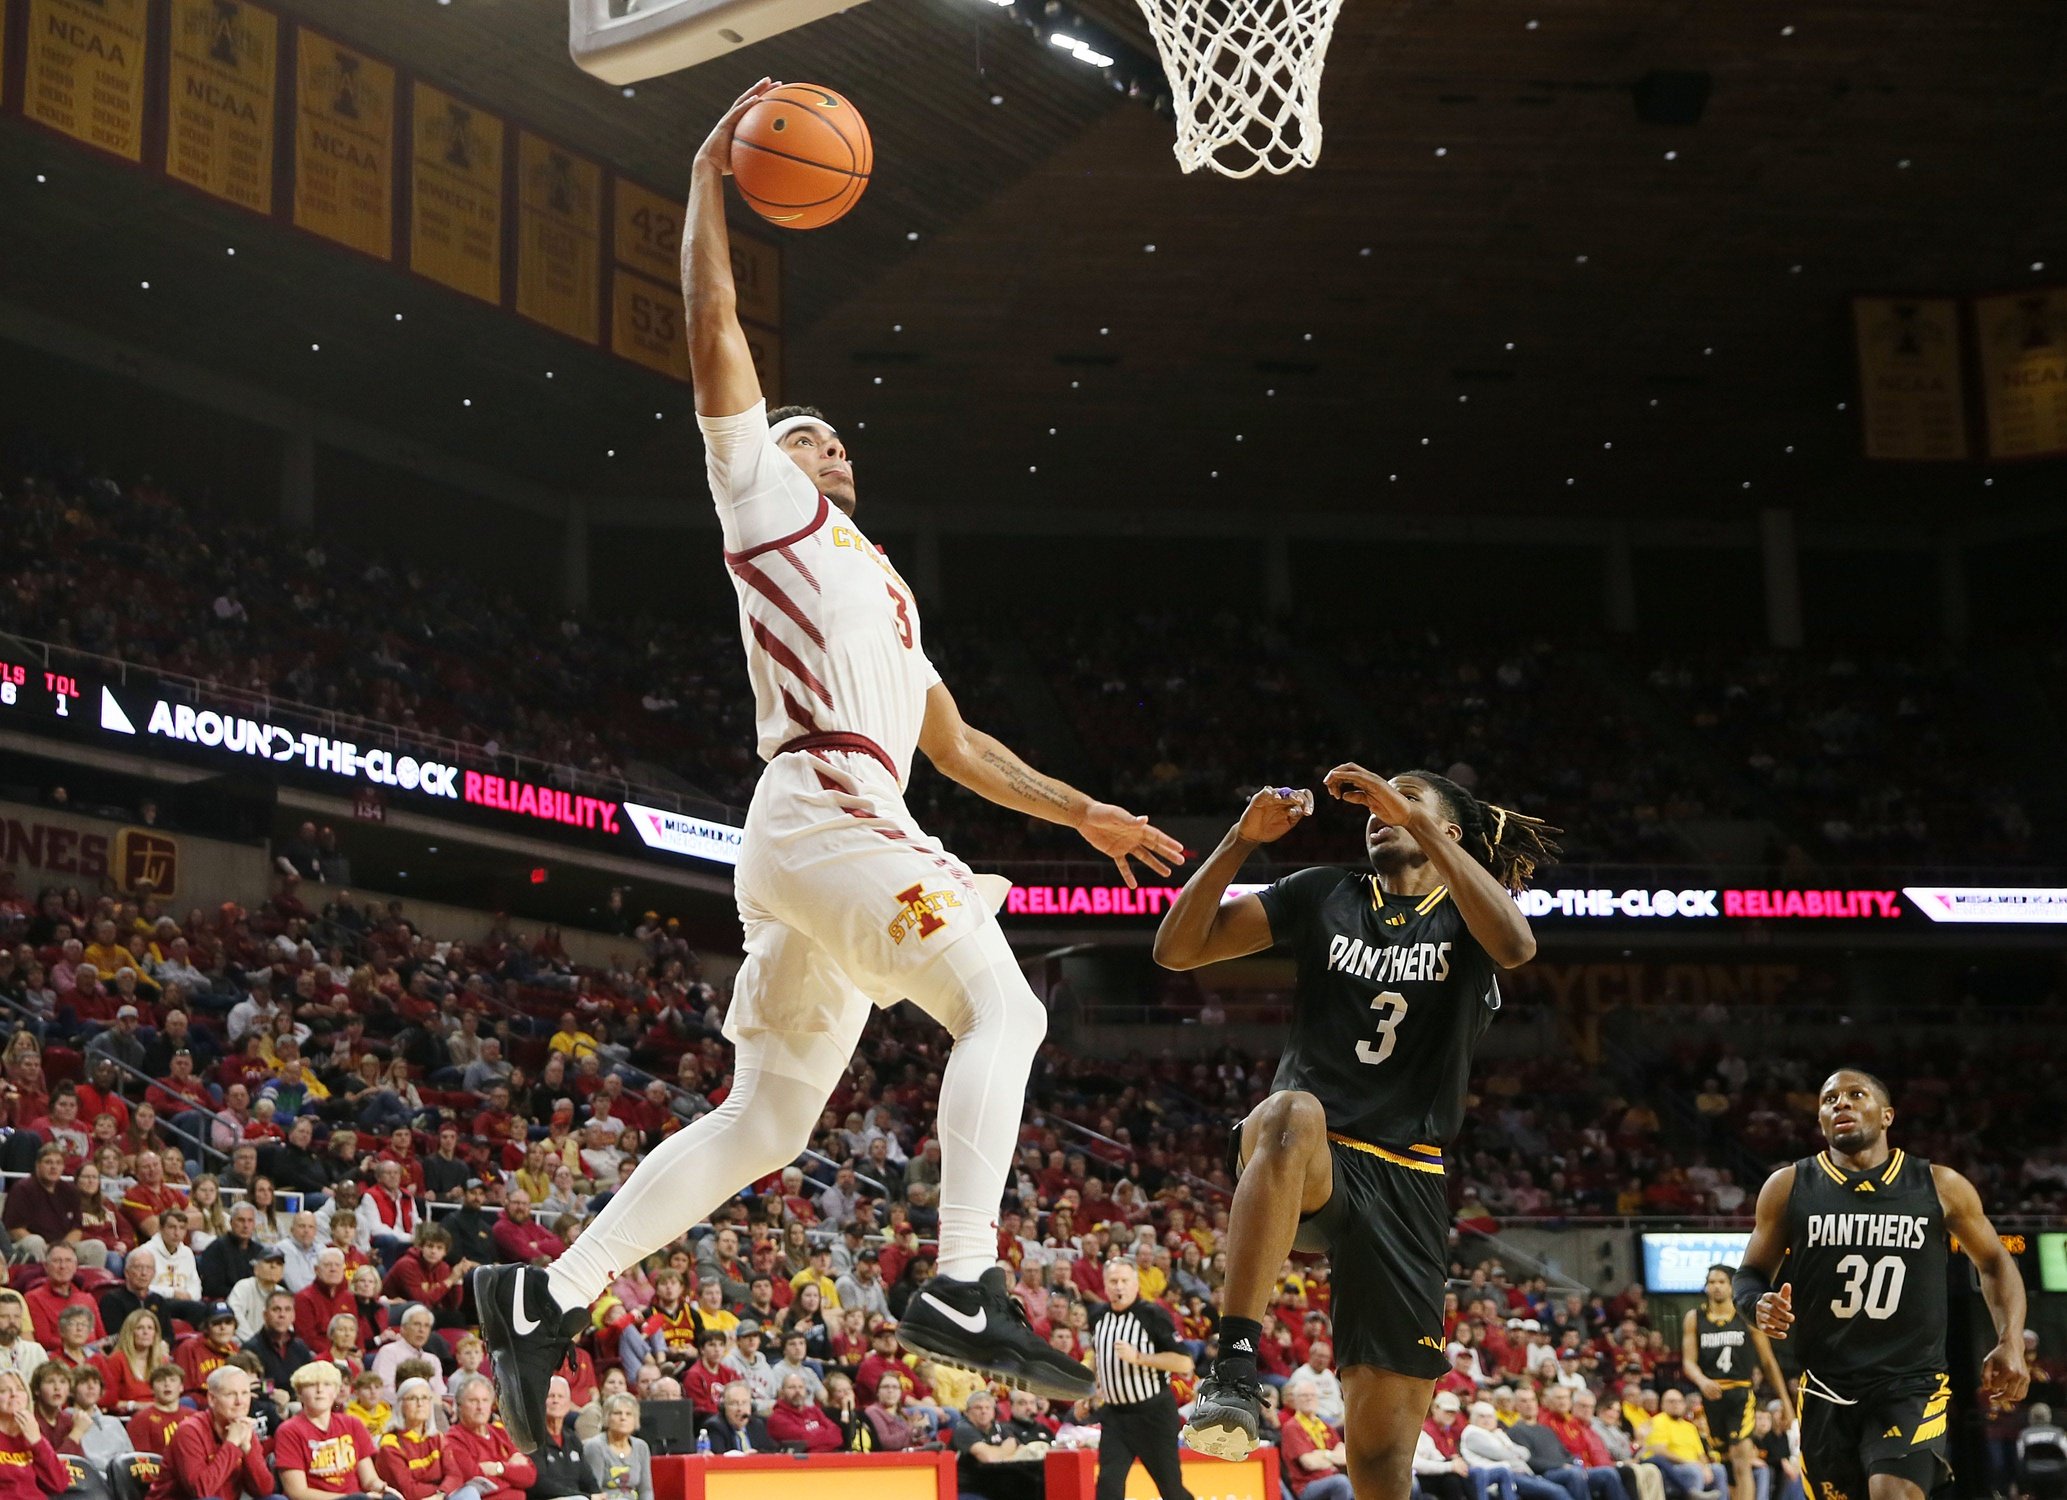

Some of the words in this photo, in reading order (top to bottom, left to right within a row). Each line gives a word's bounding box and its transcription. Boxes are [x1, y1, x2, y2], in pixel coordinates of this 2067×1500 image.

[49, 13, 125, 69] NCAA
[186, 74, 257, 126] NCAA
[312, 128, 377, 174] NCAA
[632, 207, 676, 247] 42
[631, 293, 676, 342] 53
[885, 581, 913, 650] 3
[0, 681, 17, 706] 6
[56, 693, 69, 717] 1
[464, 769, 621, 835] RELIABILITY.
[0, 817, 108, 877] NES
[888, 890, 963, 945] STATE
[1723, 889, 1902, 918] RELIABILITY.
[1327, 933, 1452, 983] PANTHERS
[1354, 990, 1409, 1066] 3
[1807, 1213, 1929, 1250] PANTHERS
[1830, 1254, 1907, 1320] 30
[1715, 1345, 1733, 1373] 4
